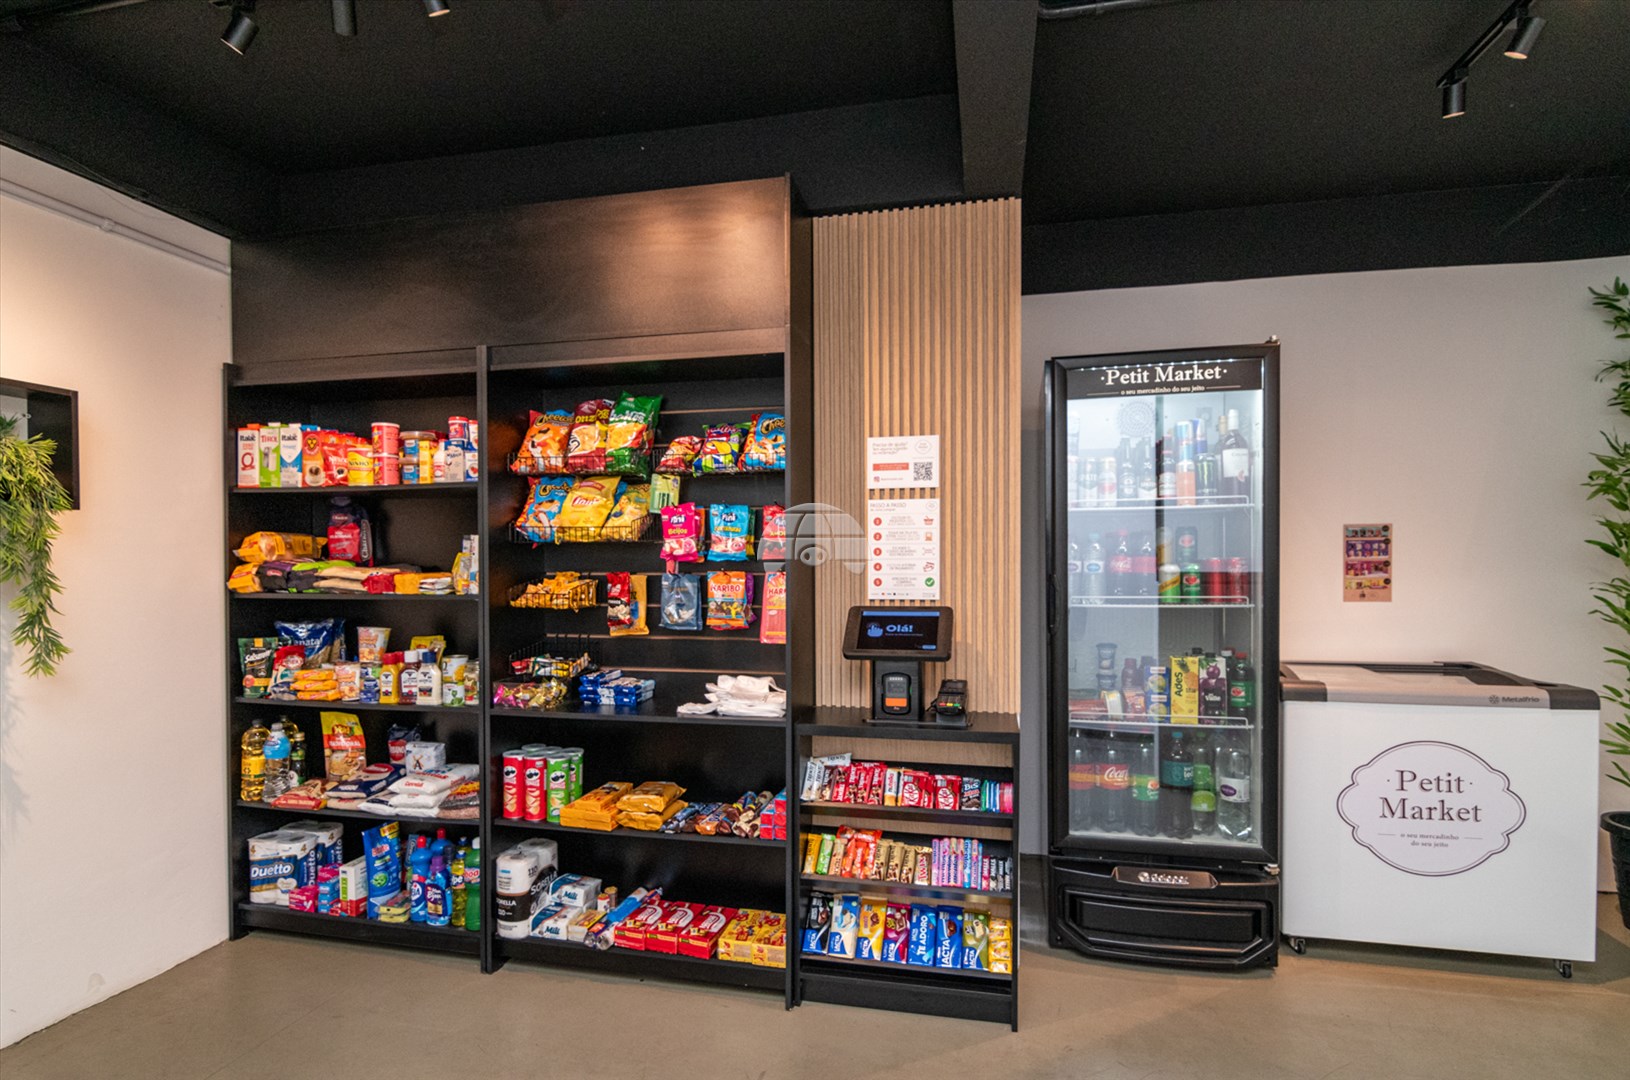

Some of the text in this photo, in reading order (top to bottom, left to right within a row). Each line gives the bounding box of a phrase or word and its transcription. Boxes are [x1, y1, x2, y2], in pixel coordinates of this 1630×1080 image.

[1105, 365, 1222, 385] Petit Market
[710, 583, 741, 592] HARIBO
[886, 624, 914, 632] Olá!
[1174, 672, 1183, 696] AdeS
[1395, 770, 1465, 794] Petit
[1379, 796, 1482, 822] Market
[1419, 833, 1459, 841] mercadinho
[251, 864, 292, 878] Duetto
[916, 915, 928, 955] TE ADORO
[942, 938, 950, 968] LACTA
